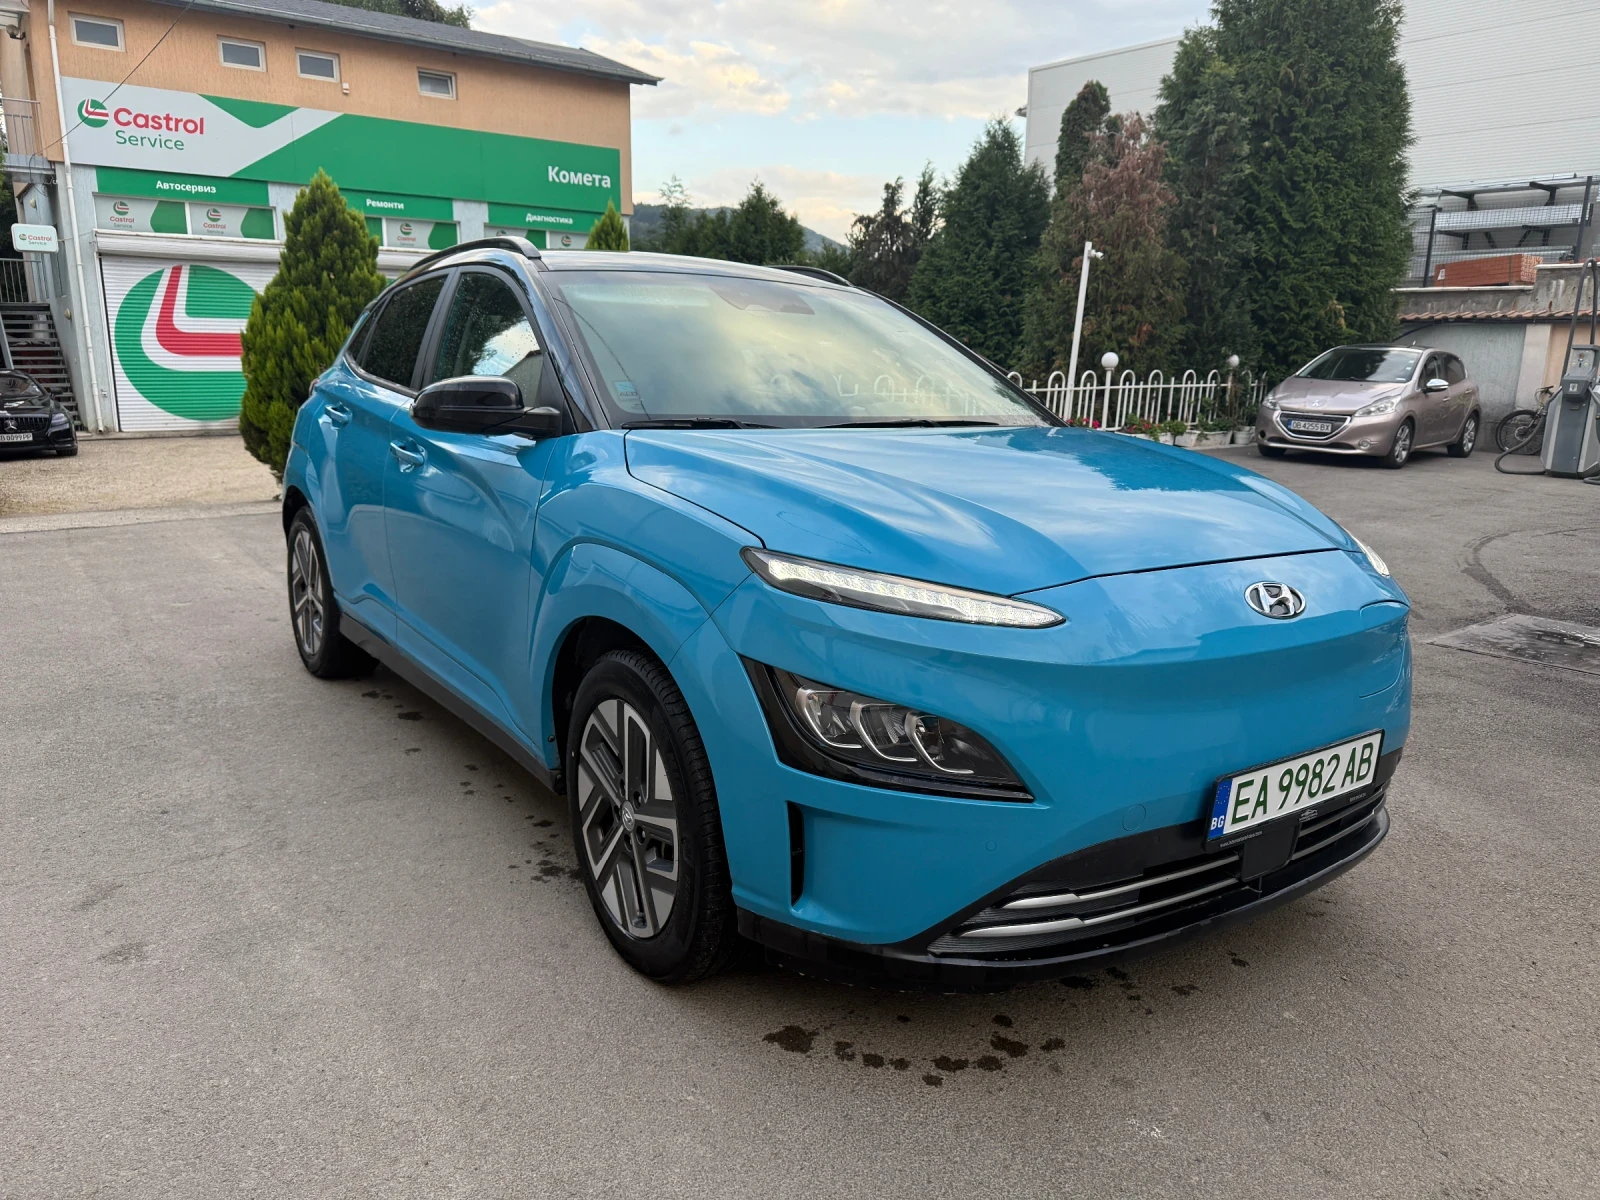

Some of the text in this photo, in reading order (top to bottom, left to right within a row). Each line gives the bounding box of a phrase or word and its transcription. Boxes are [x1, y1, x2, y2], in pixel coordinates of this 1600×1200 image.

[113, 107, 204, 135] Castrol
[115, 129, 185, 151] Service
[547, 165, 611, 189] Комета
[155, 180, 217, 194] Автосервиз
[366, 198, 405, 210] Ремонти
[109, 215, 135, 223] Castrol
[526, 213, 573, 225] Диагностика
[1302, 422, 1319, 430] 4255
[1230, 742, 1374, 825] EA 9982 AB
[1210, 815, 1225, 831] BG
